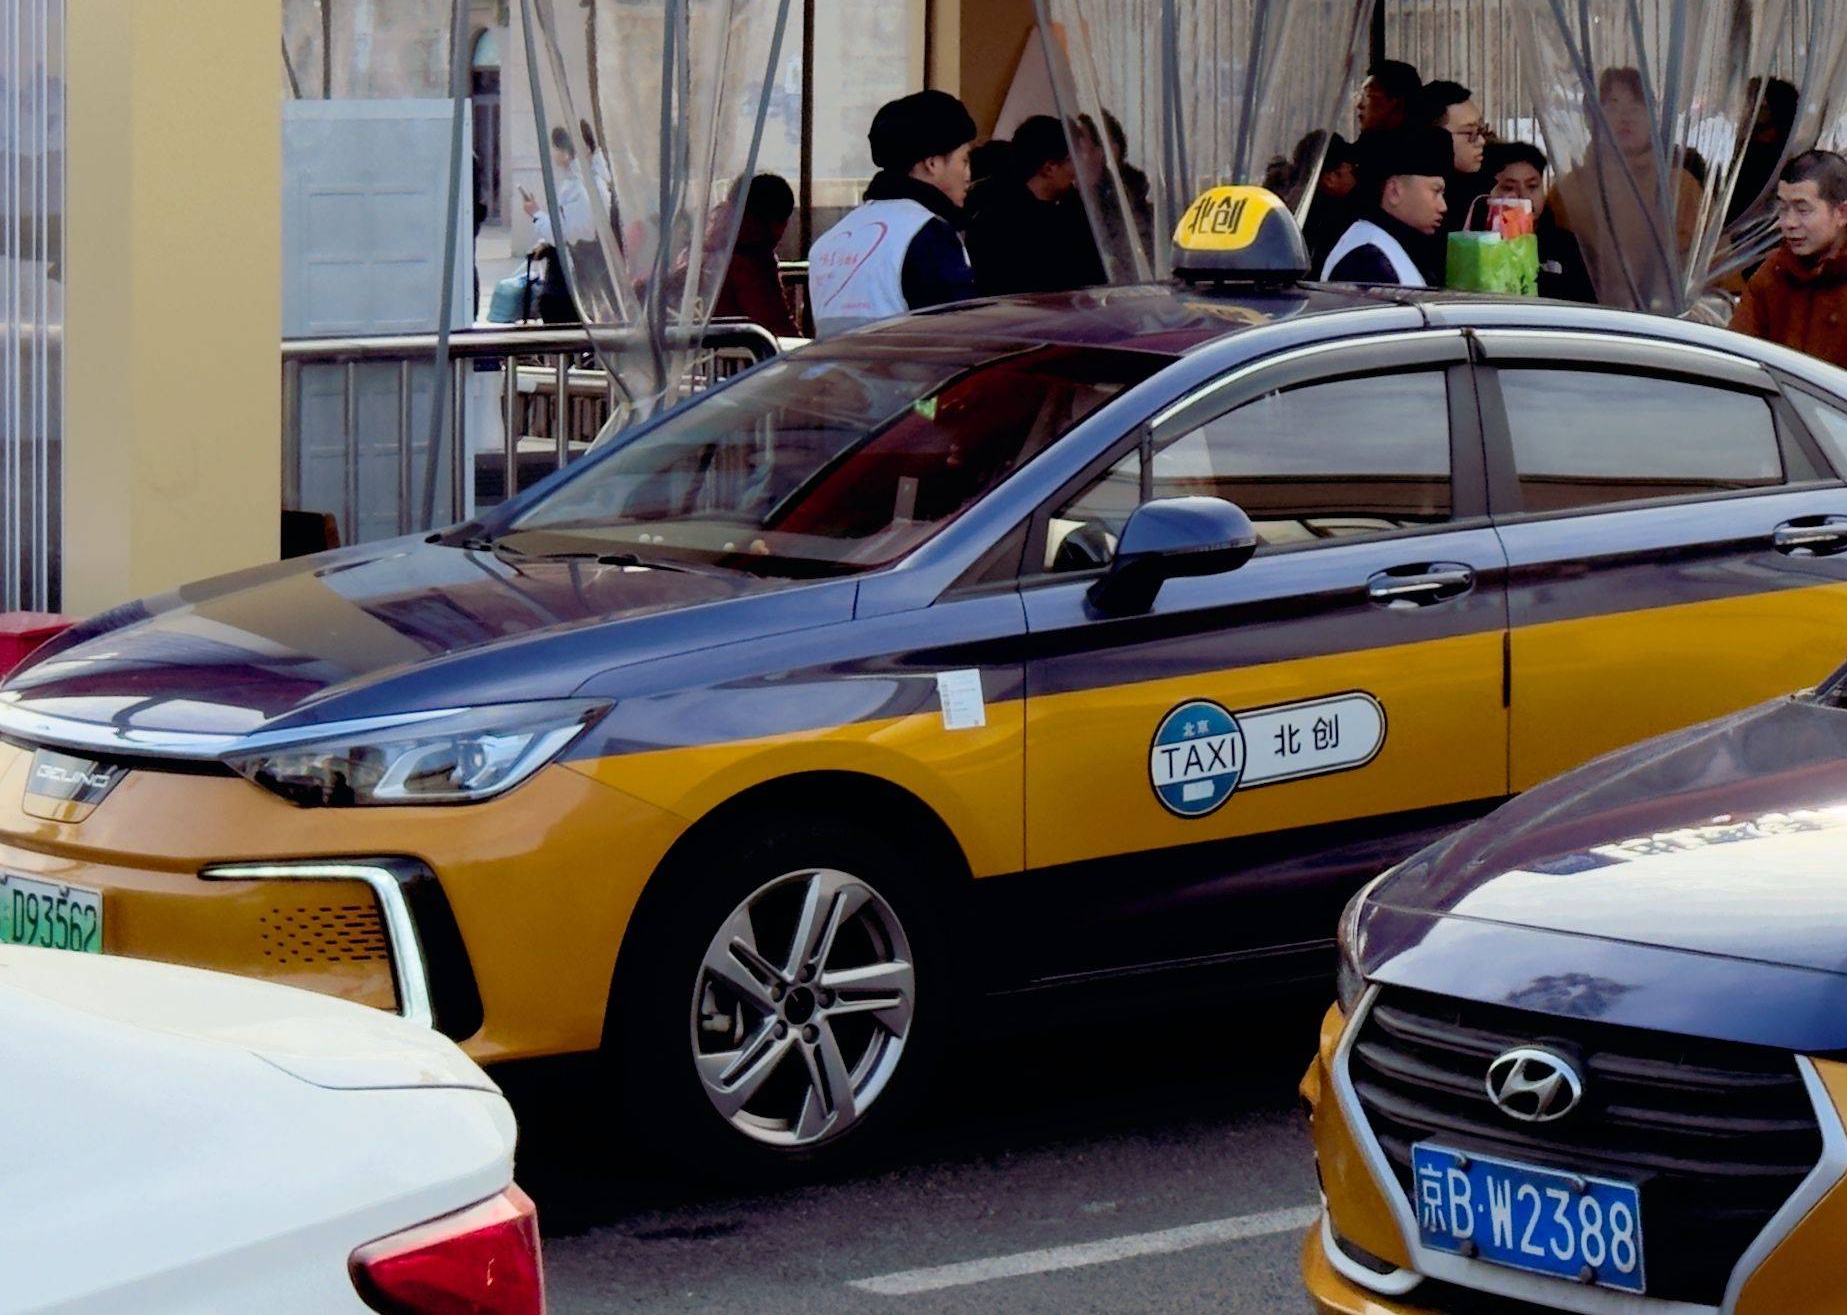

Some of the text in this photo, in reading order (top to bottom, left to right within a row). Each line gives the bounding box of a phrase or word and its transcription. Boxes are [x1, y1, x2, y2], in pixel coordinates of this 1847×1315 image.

[1187, 195, 1249, 236] 北创
[1182, 718, 1211, 737] 北京
[1274, 713, 1340, 757] 北创
[1161, 736, 1236, 779] TAXI
